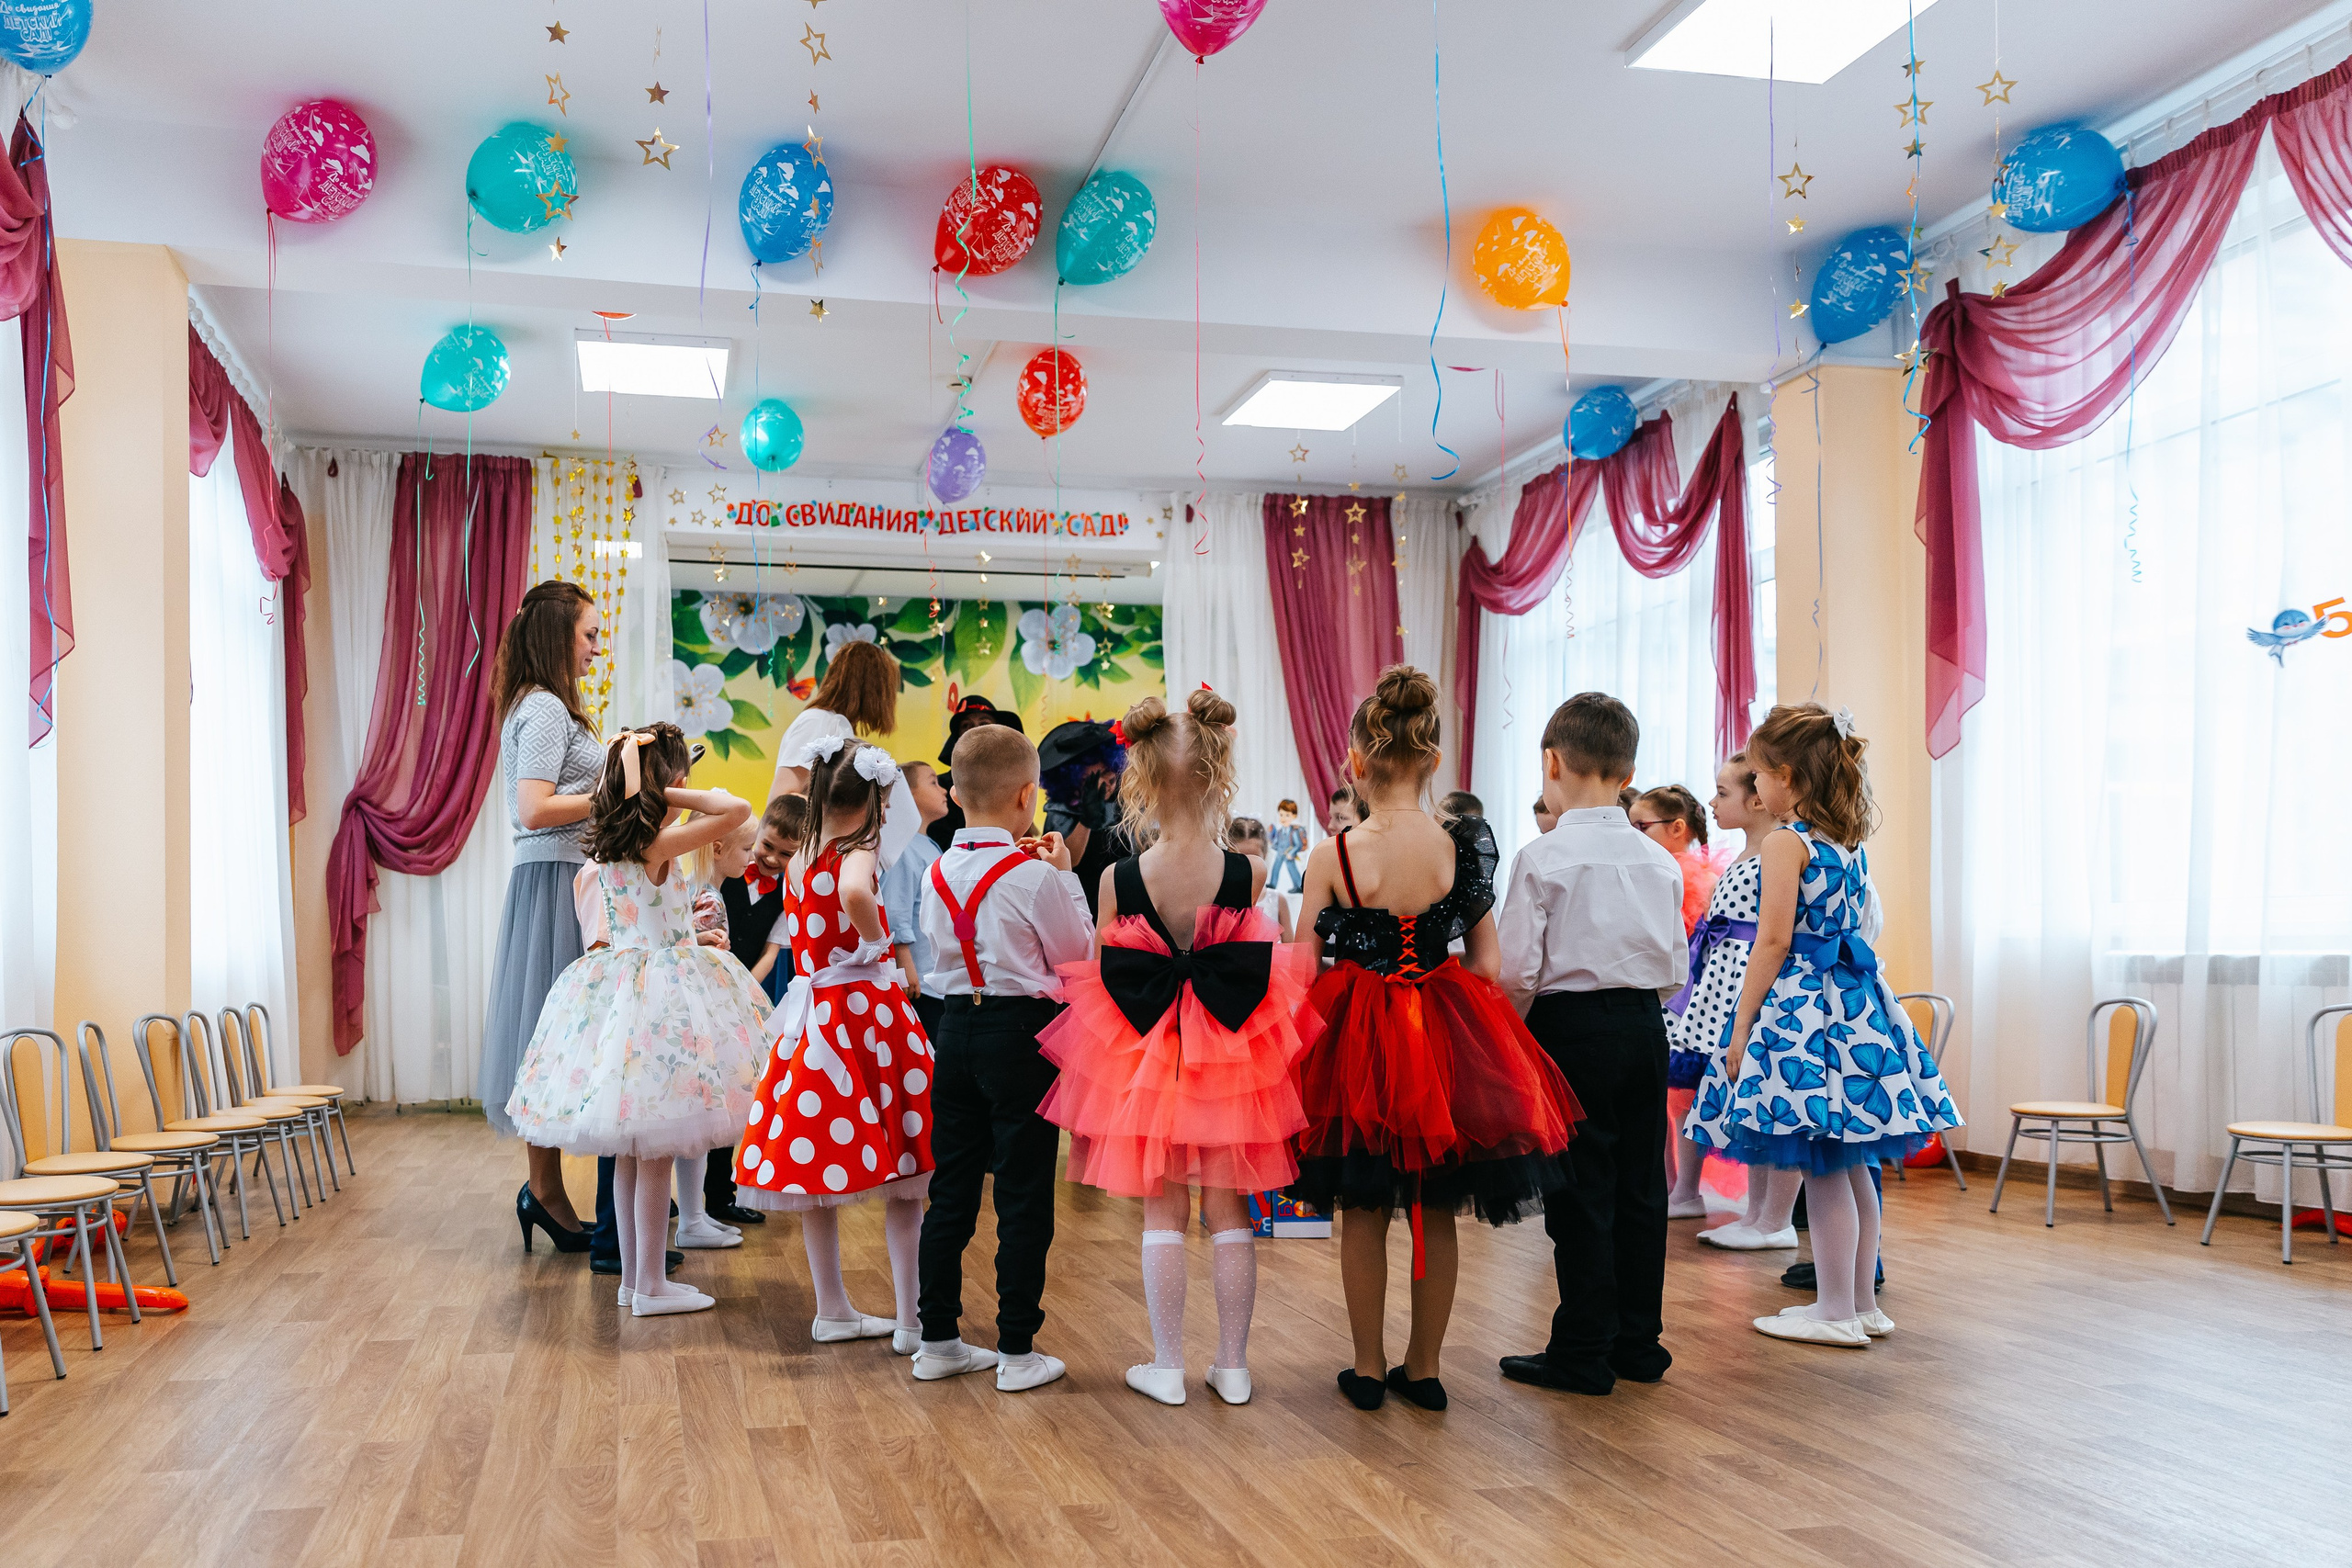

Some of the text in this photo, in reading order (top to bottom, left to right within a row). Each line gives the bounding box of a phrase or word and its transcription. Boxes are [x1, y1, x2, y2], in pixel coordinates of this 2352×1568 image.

[735, 502, 1125, 537] ДО СВИДАНИЯ, ДЕТСКИЙ САД!
[2312, 596, 2352, 638] 5
